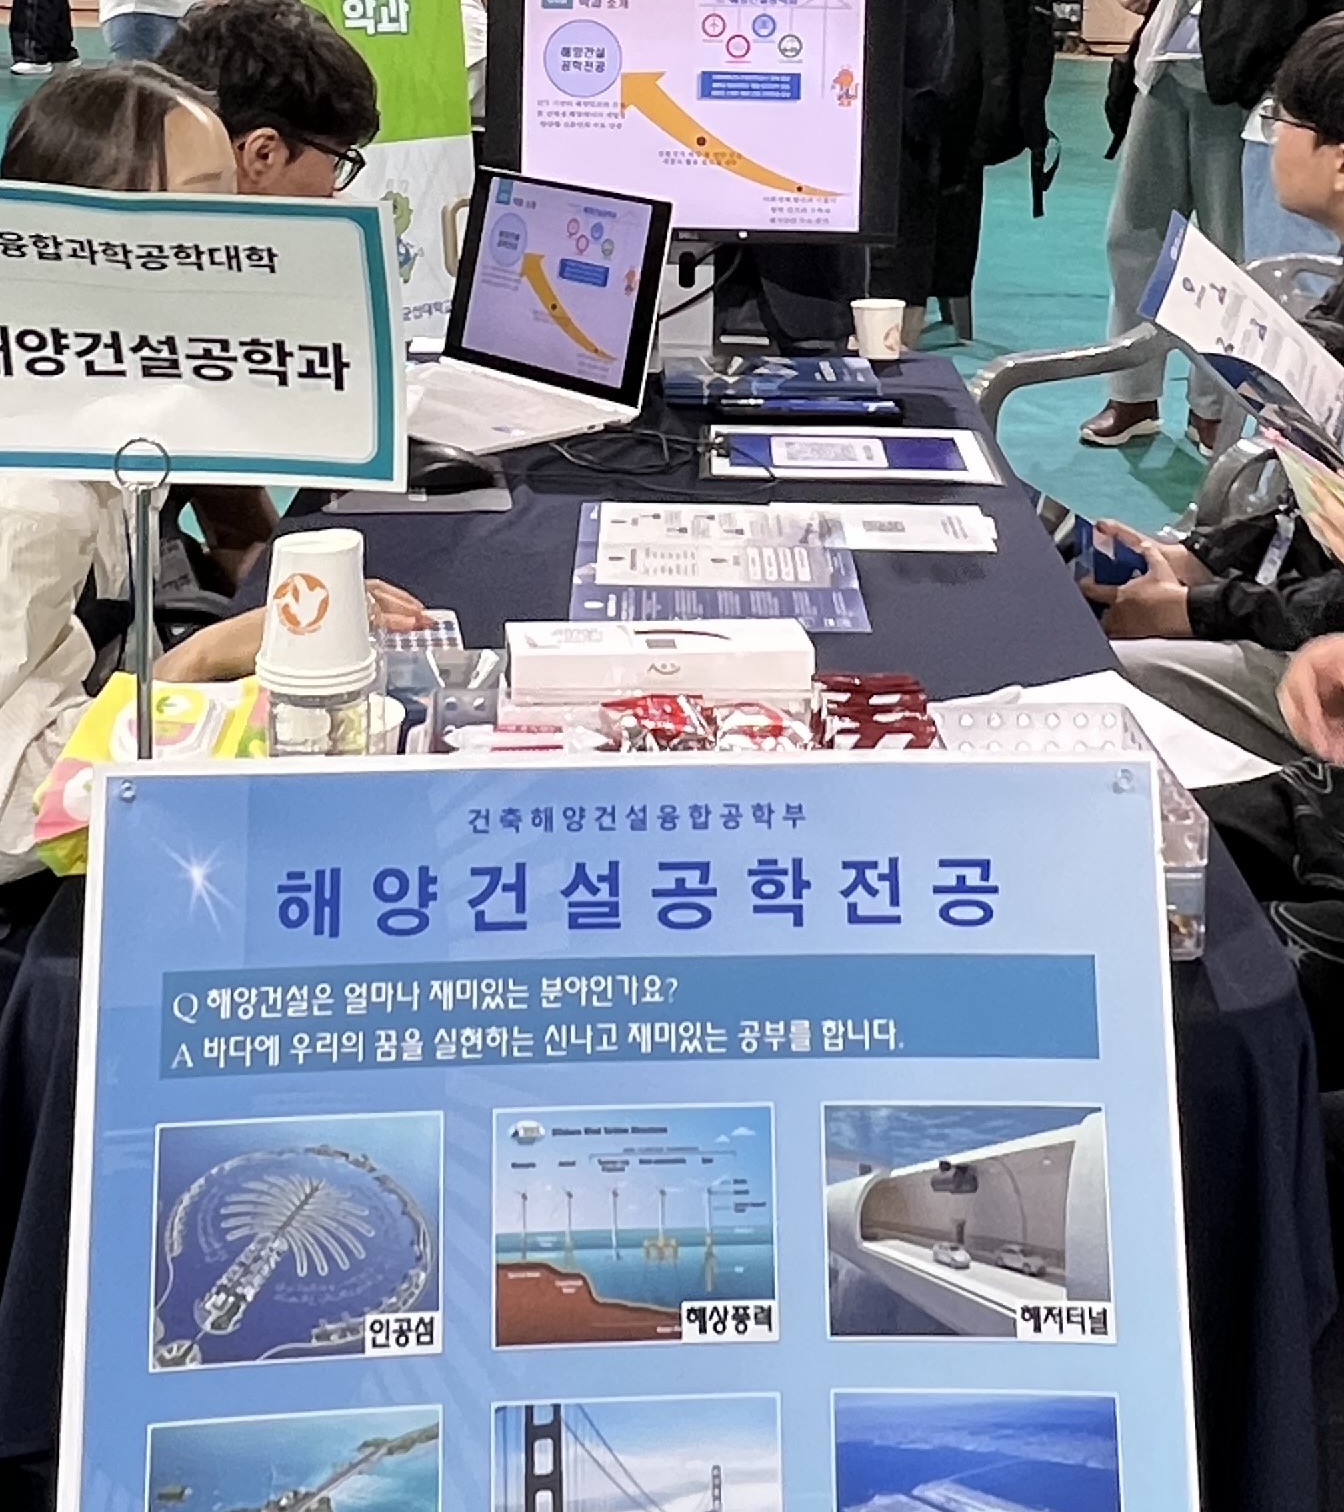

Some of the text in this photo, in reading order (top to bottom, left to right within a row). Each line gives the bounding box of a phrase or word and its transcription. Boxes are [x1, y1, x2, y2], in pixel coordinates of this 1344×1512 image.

[467, 802, 807, 835] 건축해양건설융합공학부
[276, 856, 1000, 938] 해양건설공학전공
[172, 974, 679, 1025] Q 해양건설은 얼마나 재미있는 분야인가요?
[170, 1018, 906, 1070] A 바다에 우리의 꿈을 실현하는 신나고 재미있는 공부를 합니다.
[369, 1315, 435, 1348] 인공섬
[686, 1304, 773, 1335] 해상풍력
[1020, 1305, 1109, 1336] 해저터널
